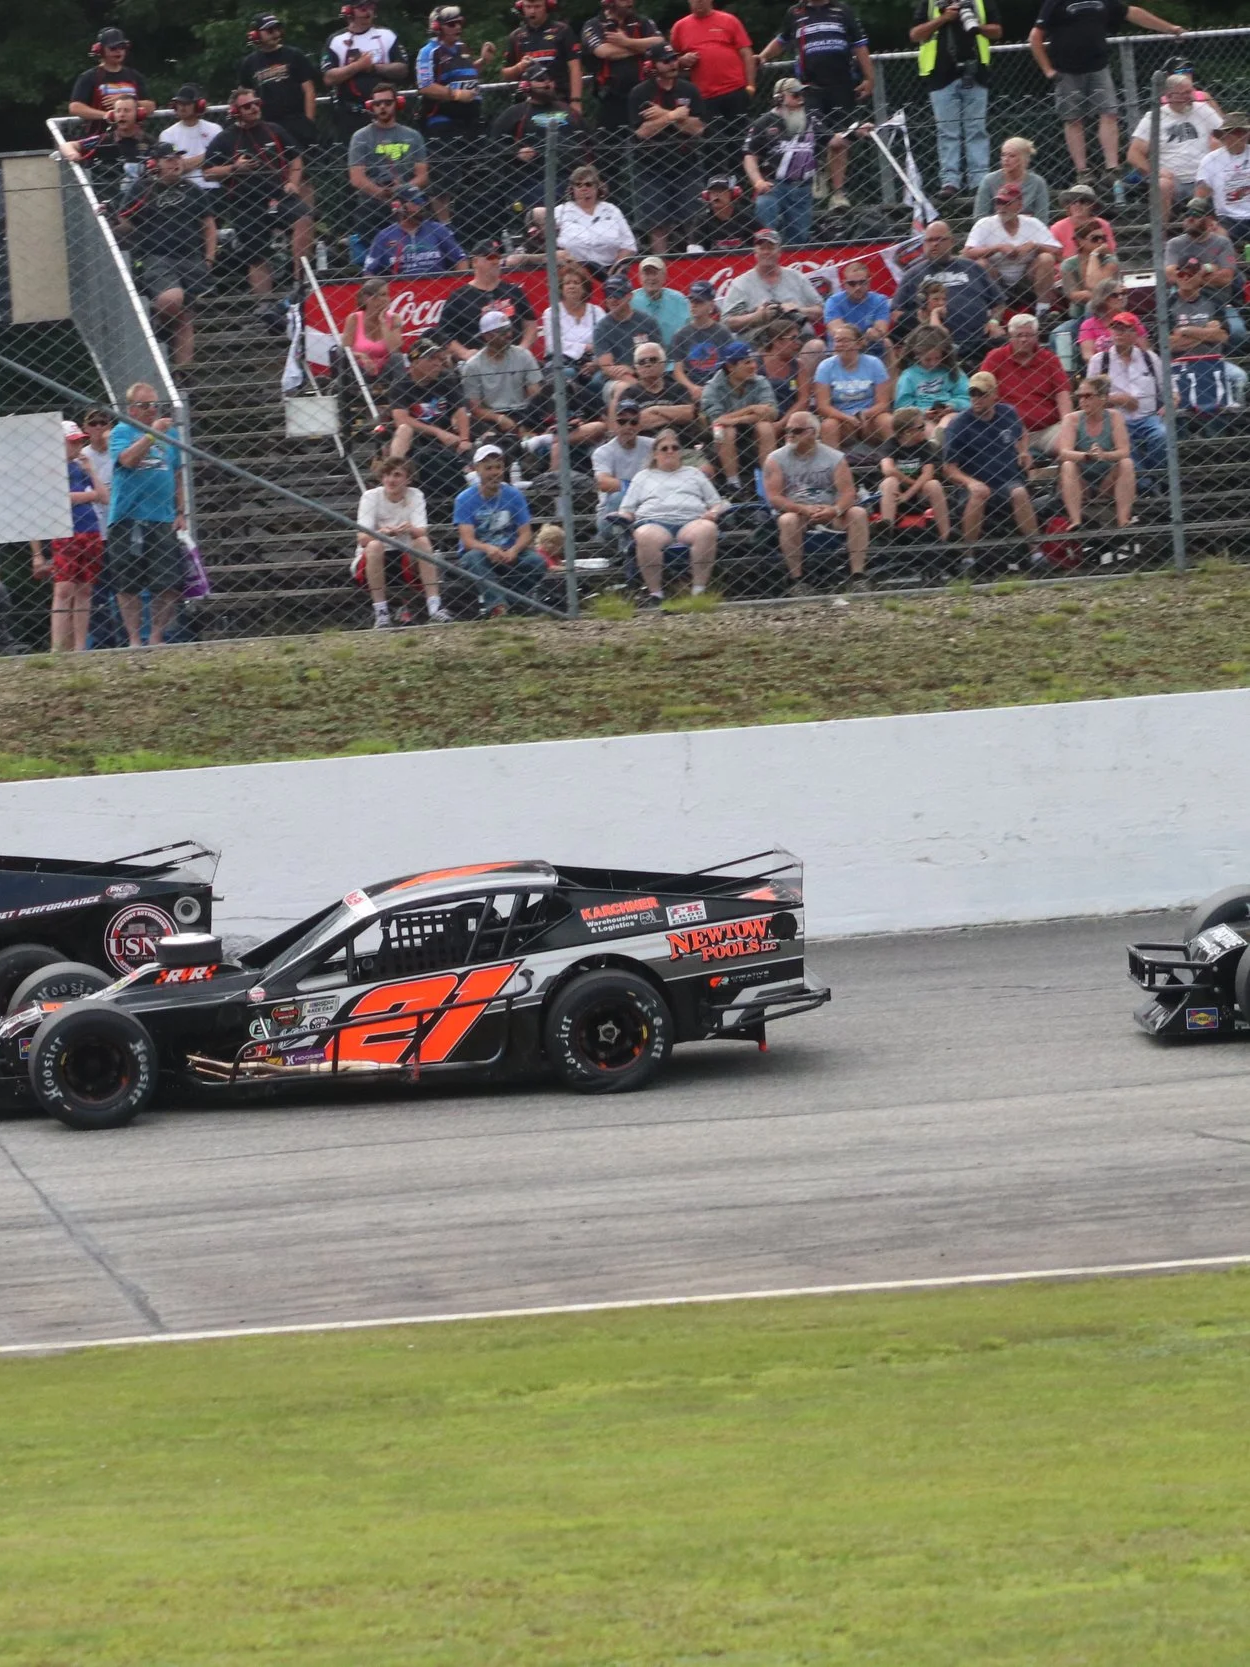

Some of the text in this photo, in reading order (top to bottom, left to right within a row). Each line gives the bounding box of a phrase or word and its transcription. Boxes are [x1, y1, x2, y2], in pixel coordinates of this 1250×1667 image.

[388, 290, 447, 326] Coca
[17, 894, 101, 917] PERFORMANCE
[580, 896, 660, 921] KARCHNER
[586, 913, 639, 928] Warehousing
[598, 920, 635, 934] Logistics
[666, 916, 774, 961] NEWTOW
[701, 938, 778, 962] POOLS LLC
[42, 1036, 65, 1101] Hoosier
[129, 1038, 150, 1106] Hoosier
